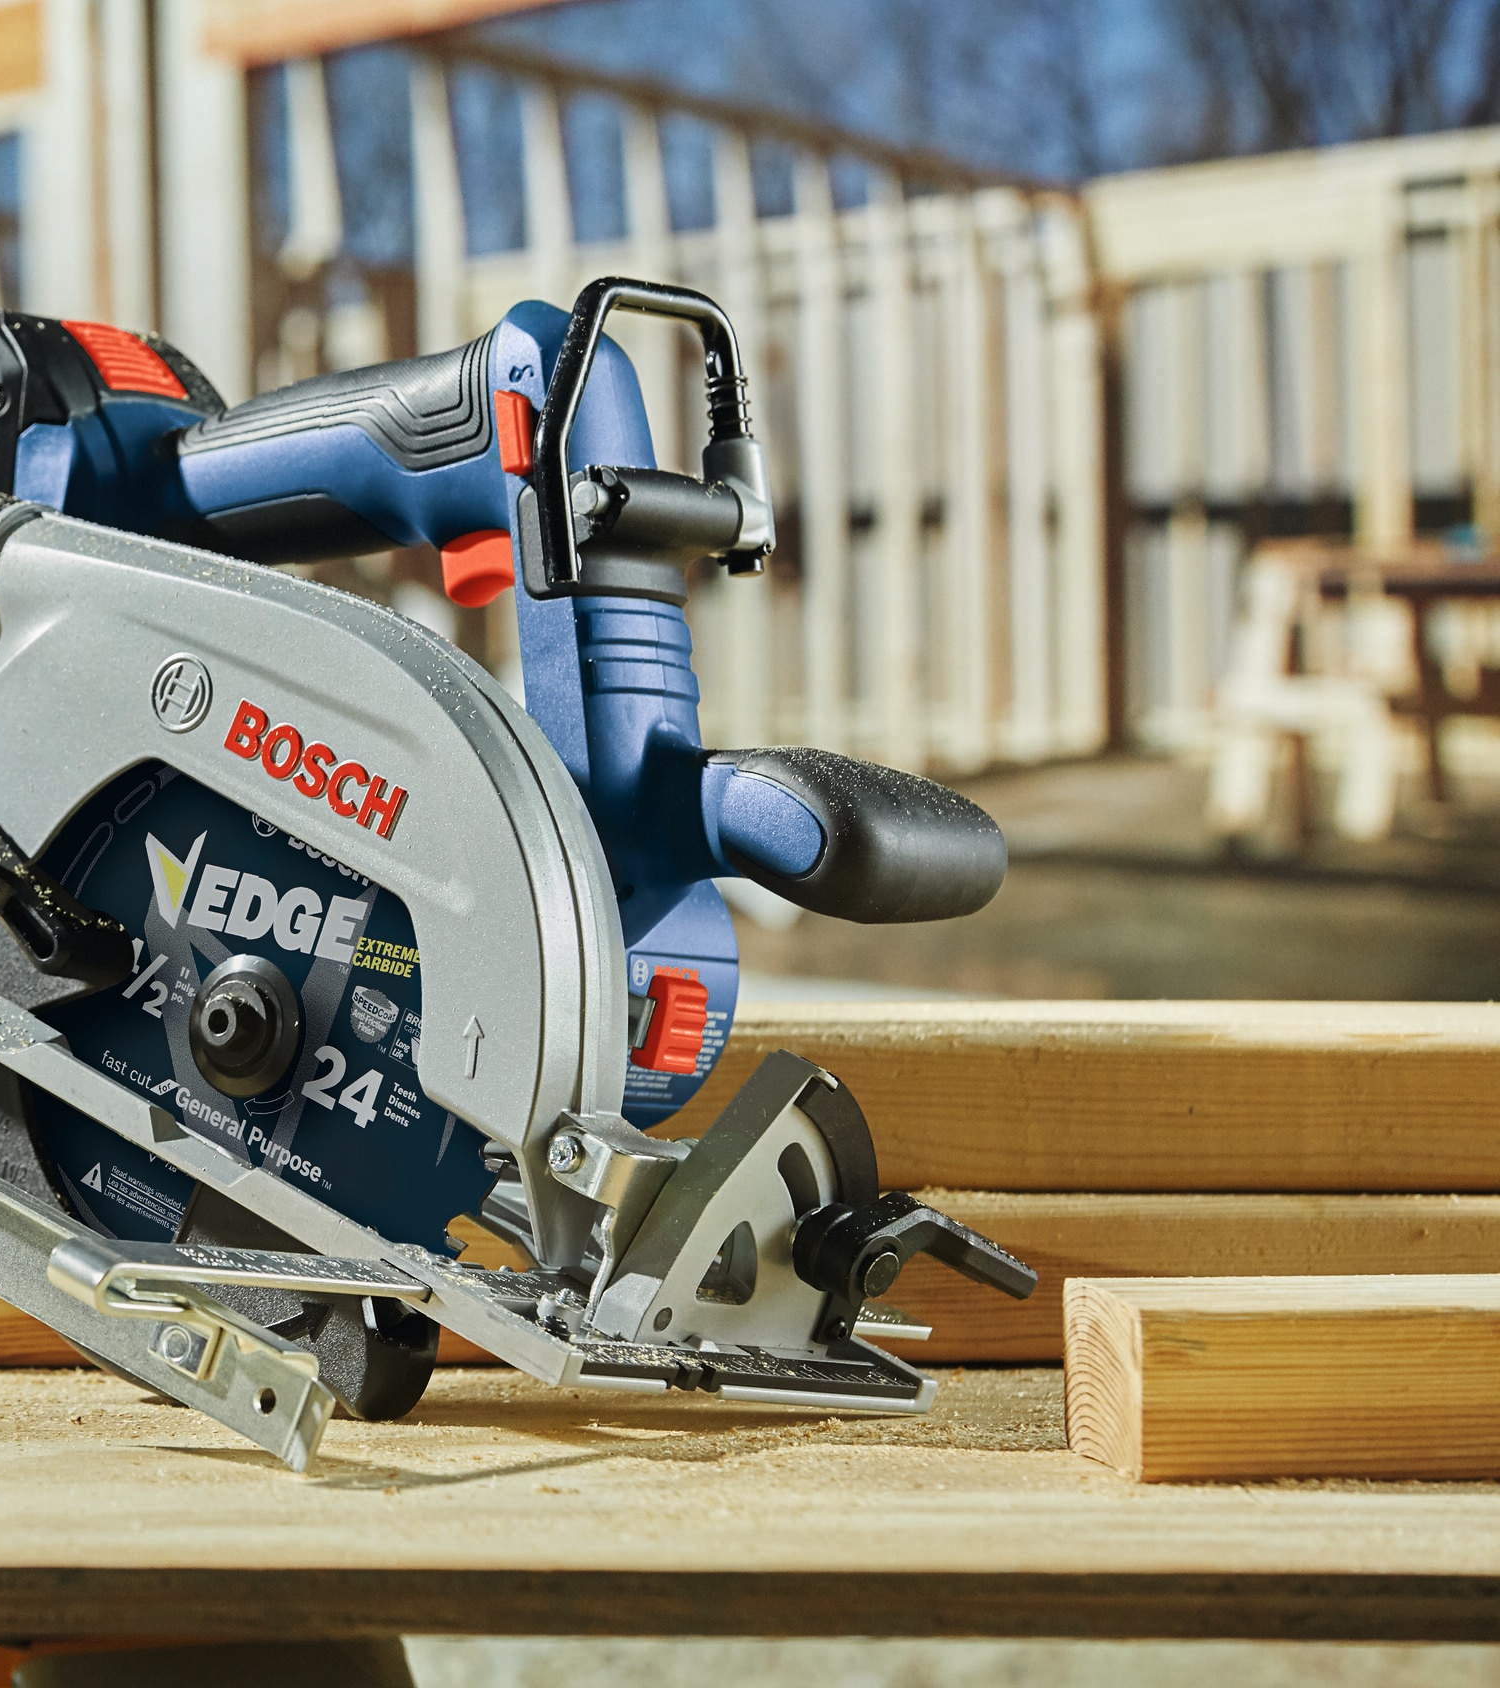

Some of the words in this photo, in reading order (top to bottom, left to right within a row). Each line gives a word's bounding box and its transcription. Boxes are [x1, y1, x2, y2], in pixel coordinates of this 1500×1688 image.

[224, 698, 409, 840] BOSCH
[352, 952, 415, 978] CARBIDE
[170, 992, 185, 1005] po.
[174, 980, 196, 997] pulg.
[391, 1048, 405, 1060] Life
[395, 1038, 410, 1053] Long
[301, 1045, 384, 1129] 24
[393, 1082, 417, 1103] Teeth
[101, 1050, 128, 1077] fast
[129, 1069, 152, 1089] cut
[158, 1081, 172, 1095] for
[175, 1087, 247, 1141] General
[247, 1126, 323, 1183] Purpose
[383, 1106, 410, 1128] Dents
[388, 1094, 421, 1120] Dientes
[107, 1177, 119, 1188] Lea
[119, 1183, 128, 1194] las
[128, 1188, 166, 1215] advertencias
[111, 1165, 128, 1178] Read
[128, 1175, 155, 1196] warnings
[155, 1190, 182, 1209] included
[103, 1187, 116, 1200] Lire
[116, 1194, 125, 1205] les
[125, 1200, 170, 1229] avertissements
